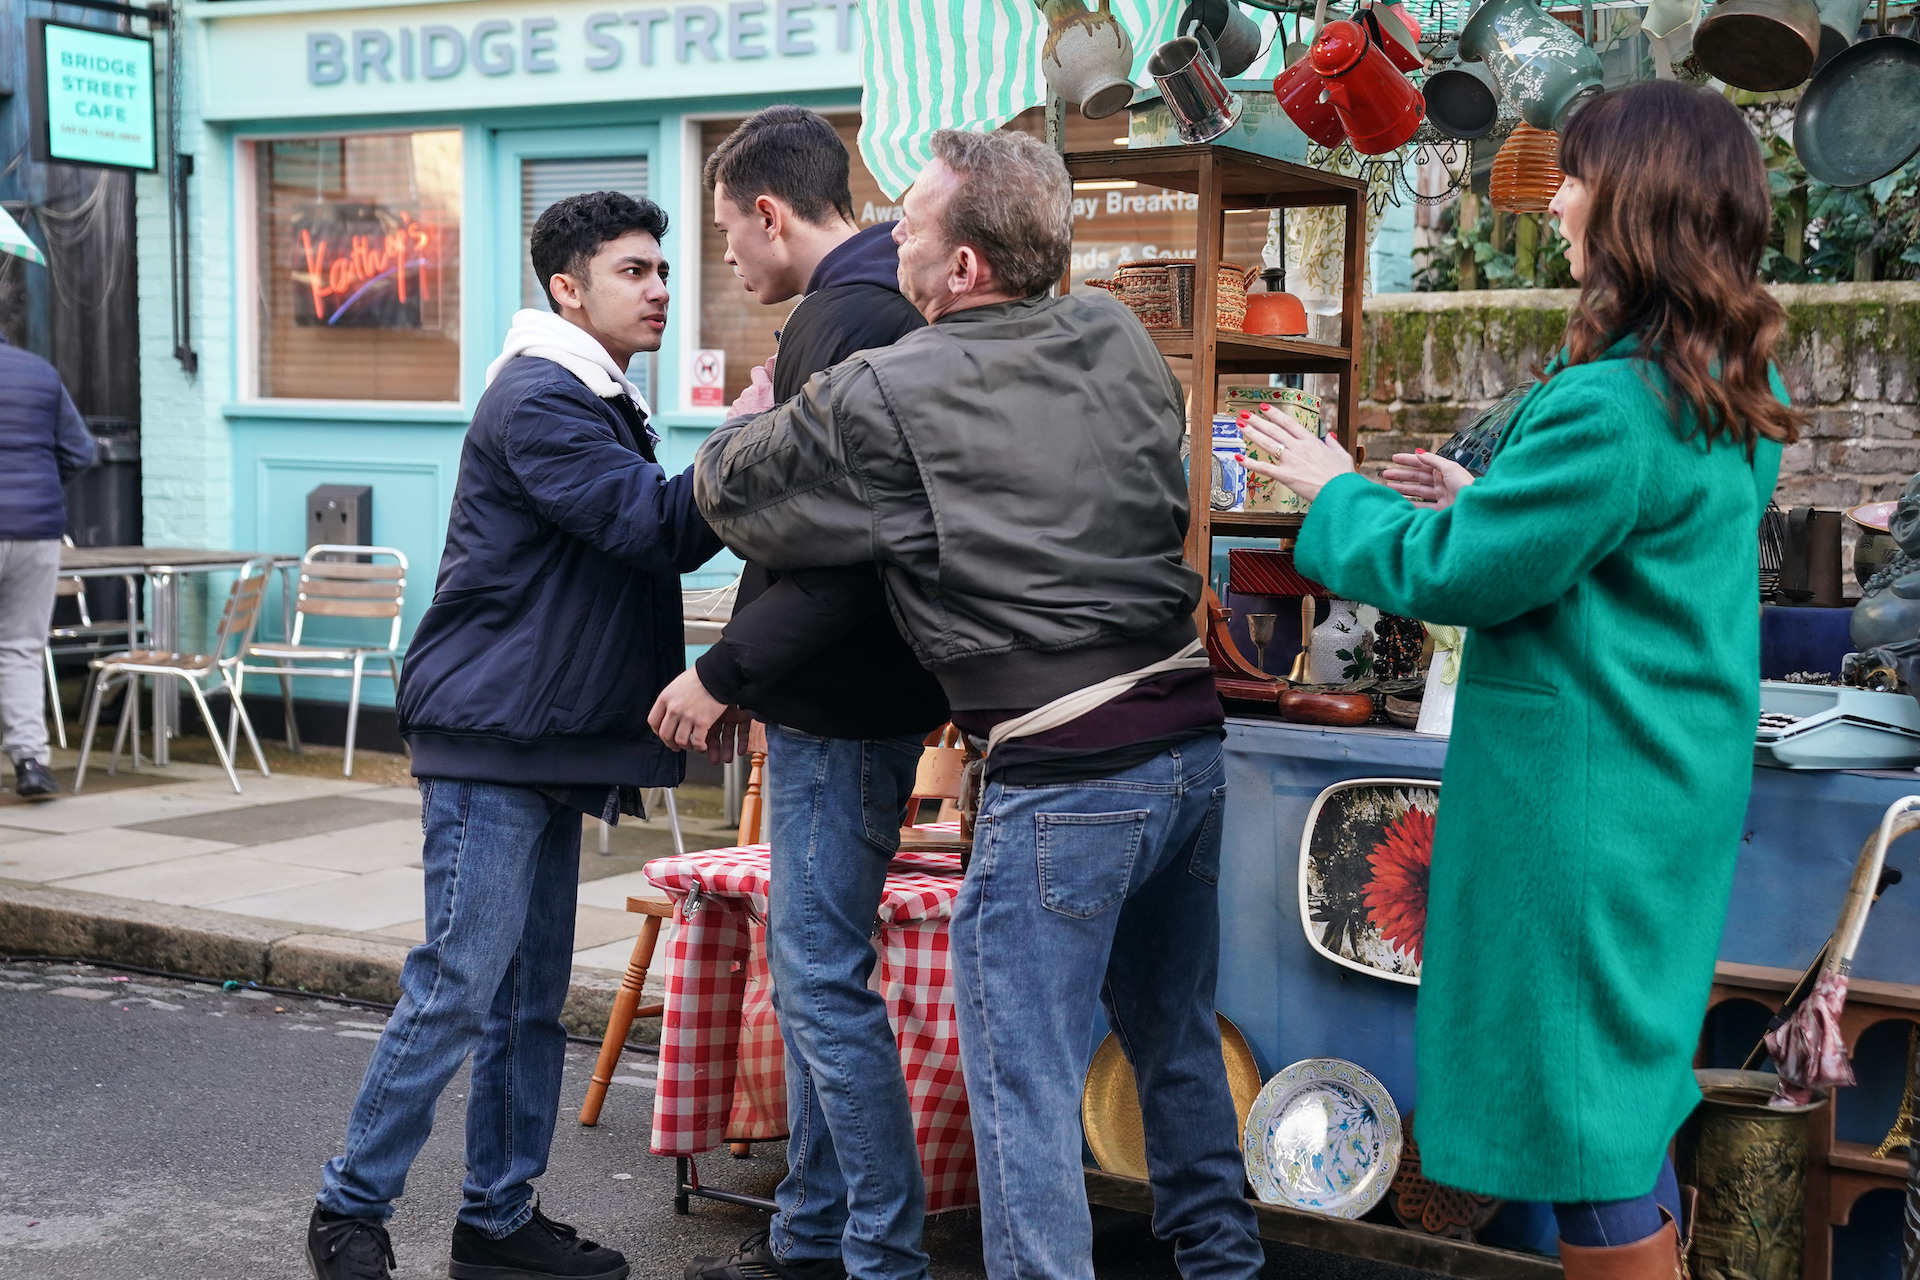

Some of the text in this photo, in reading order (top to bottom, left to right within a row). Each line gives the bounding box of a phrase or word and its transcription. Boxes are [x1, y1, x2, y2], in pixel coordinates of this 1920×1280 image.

[306, 0, 857, 86] BRIDGE STREET
[61, 50, 137, 78] BRIDGE
[61, 74, 137, 99] STREET
[75, 100, 127, 123] CAFE
[301, 210, 429, 320] Kathy's
